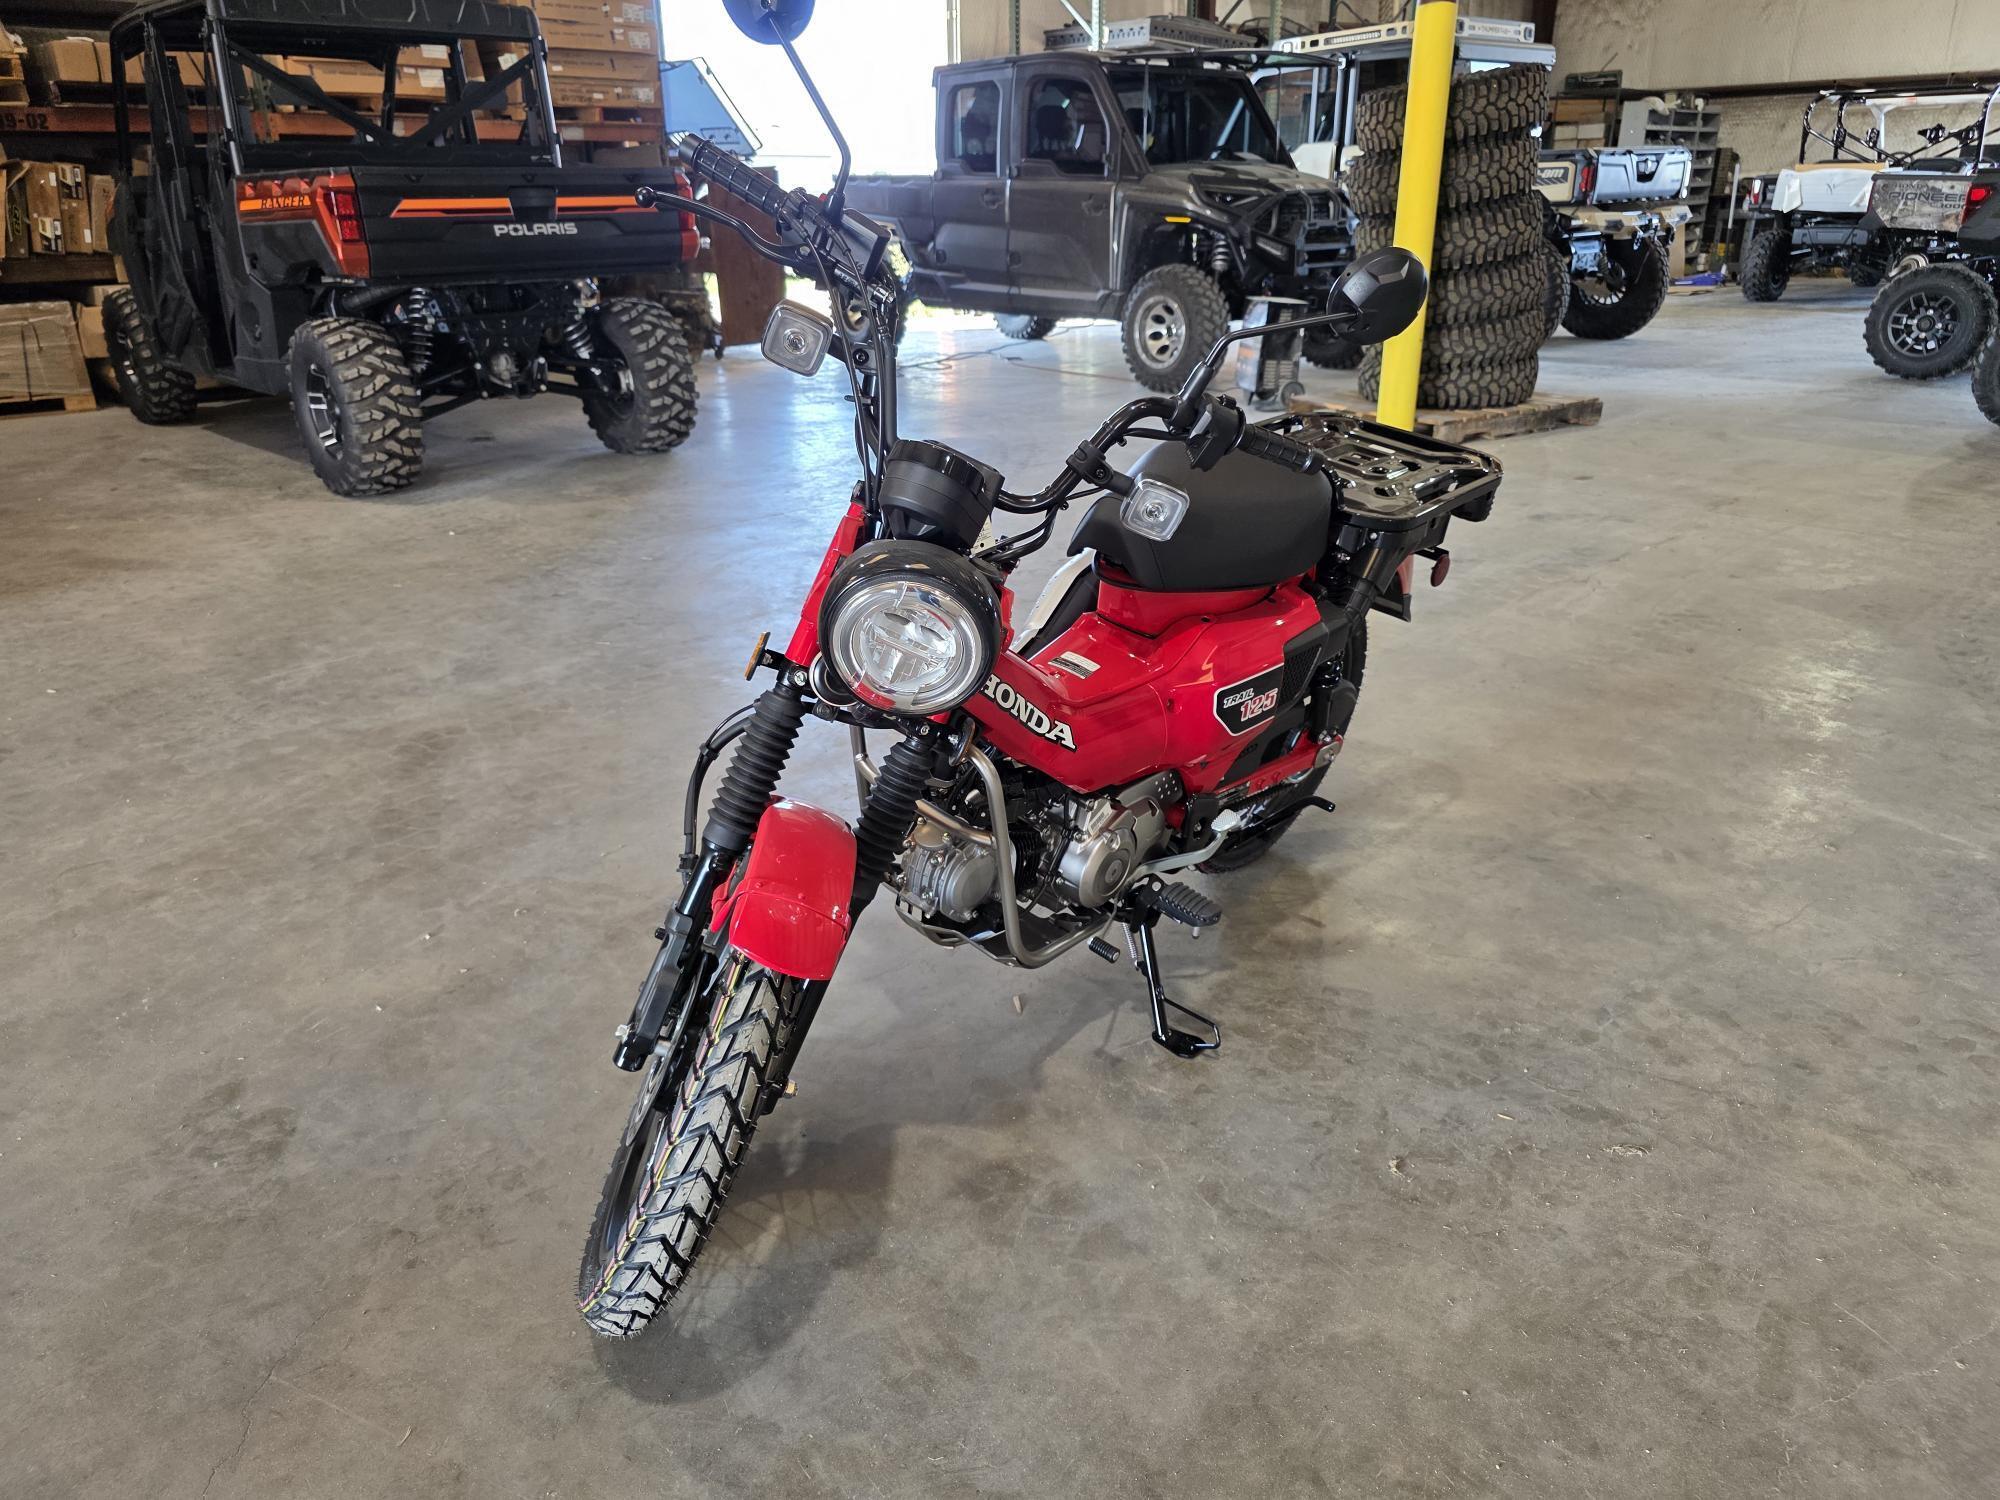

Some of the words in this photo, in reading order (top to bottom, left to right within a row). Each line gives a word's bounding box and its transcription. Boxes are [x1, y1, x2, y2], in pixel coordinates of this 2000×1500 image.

[261, 193, 305, 210] RANGER
[493, 222, 578, 237] POLARIS
[1223, 688, 1254, 708] TRAIL
[1241, 688, 1278, 721] 125
[980, 673, 1077, 751] HONDA
